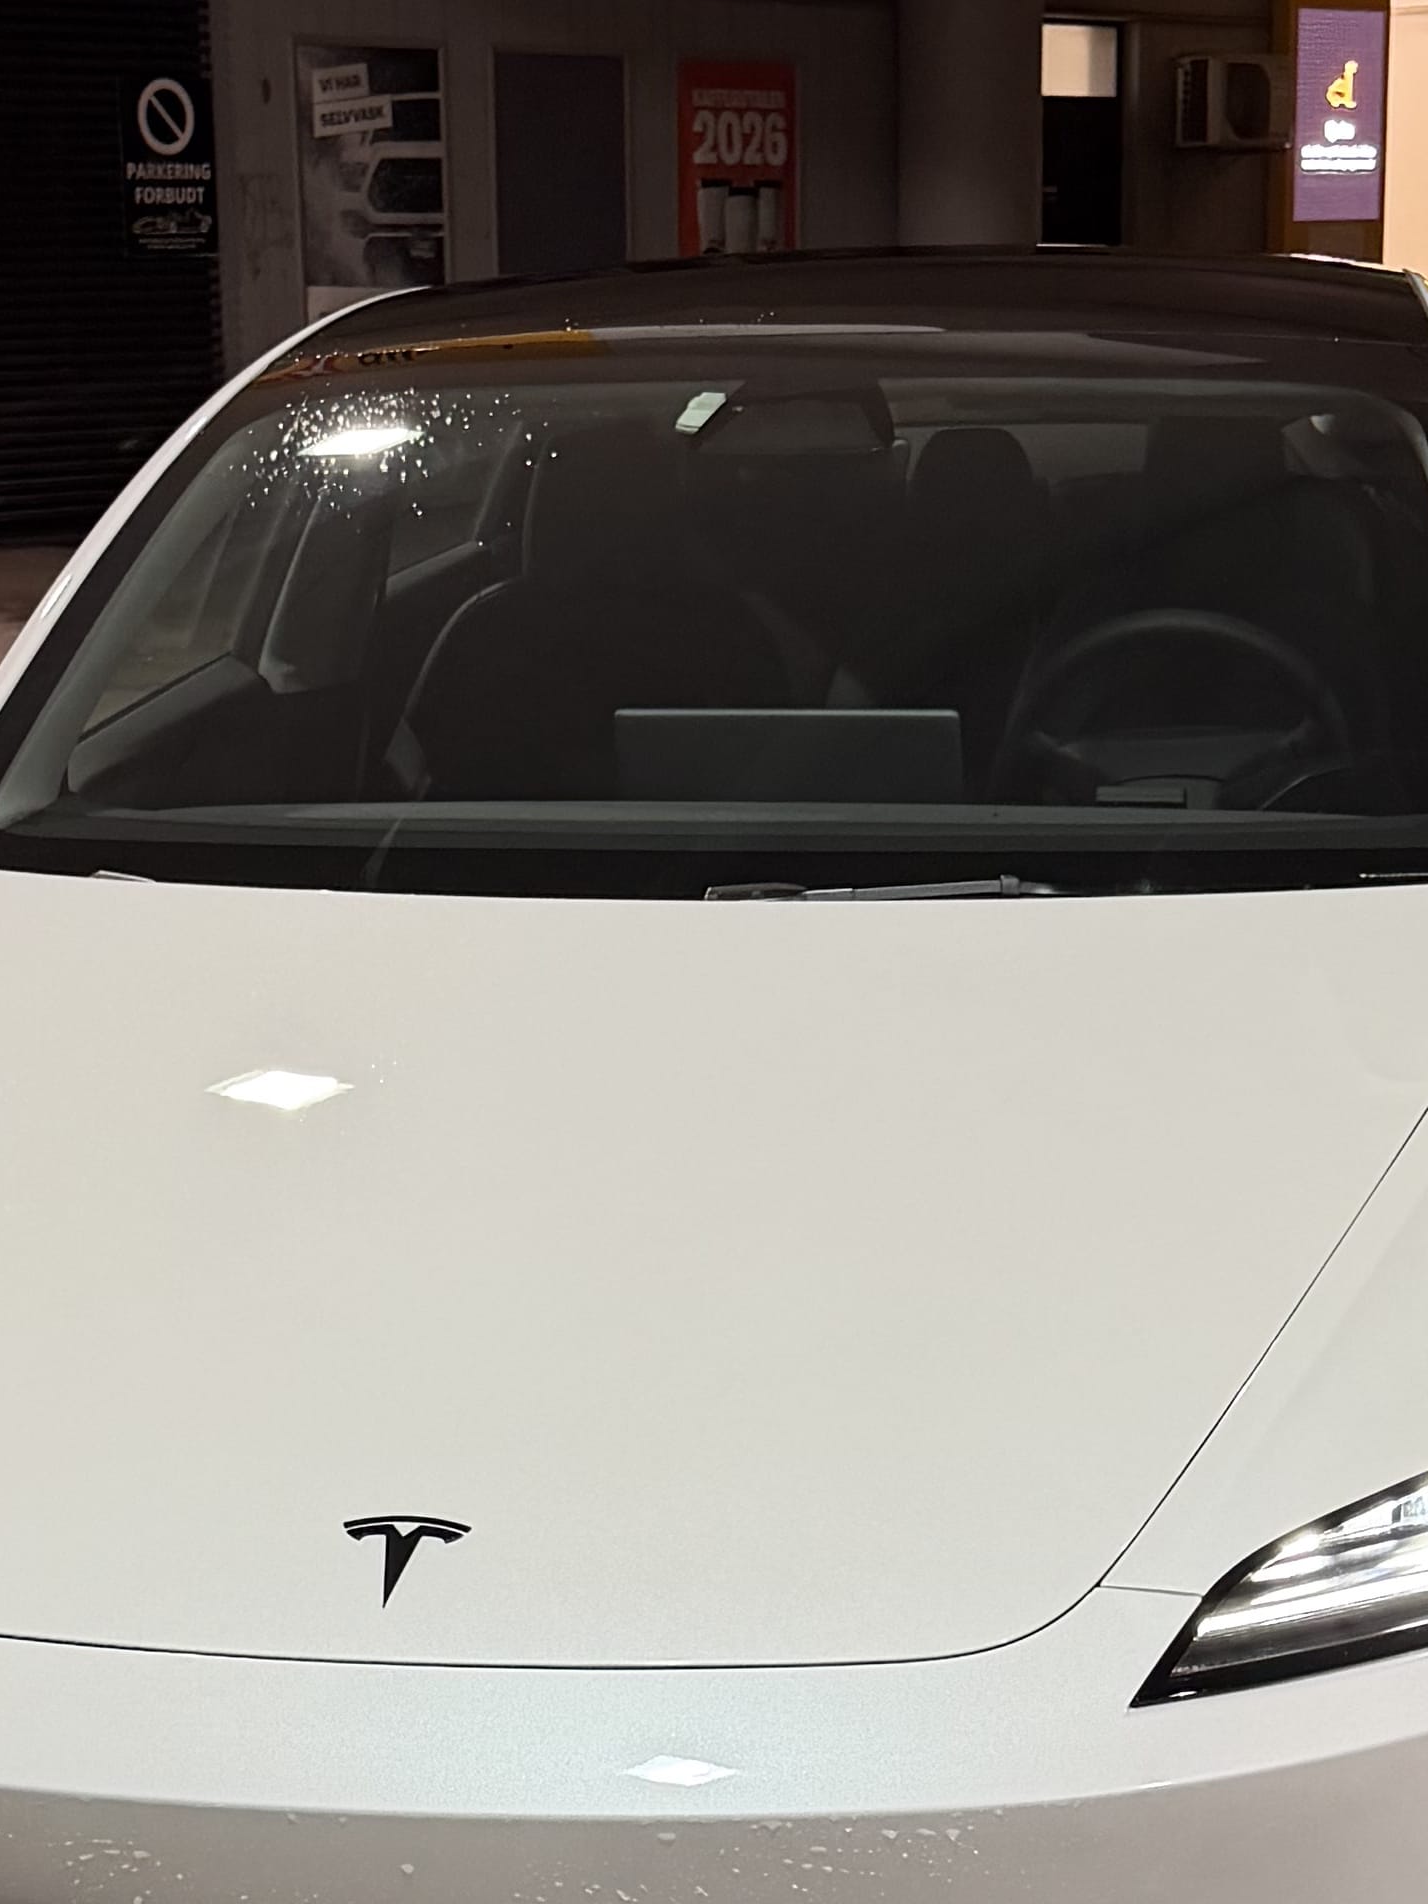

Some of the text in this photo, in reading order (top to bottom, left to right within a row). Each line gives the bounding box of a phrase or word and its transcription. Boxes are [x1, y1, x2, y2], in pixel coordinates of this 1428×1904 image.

[692, 109, 788, 166] 2026
[126, 161, 212, 181] PARKERING
[134, 186, 205, 205] FORBUDT
